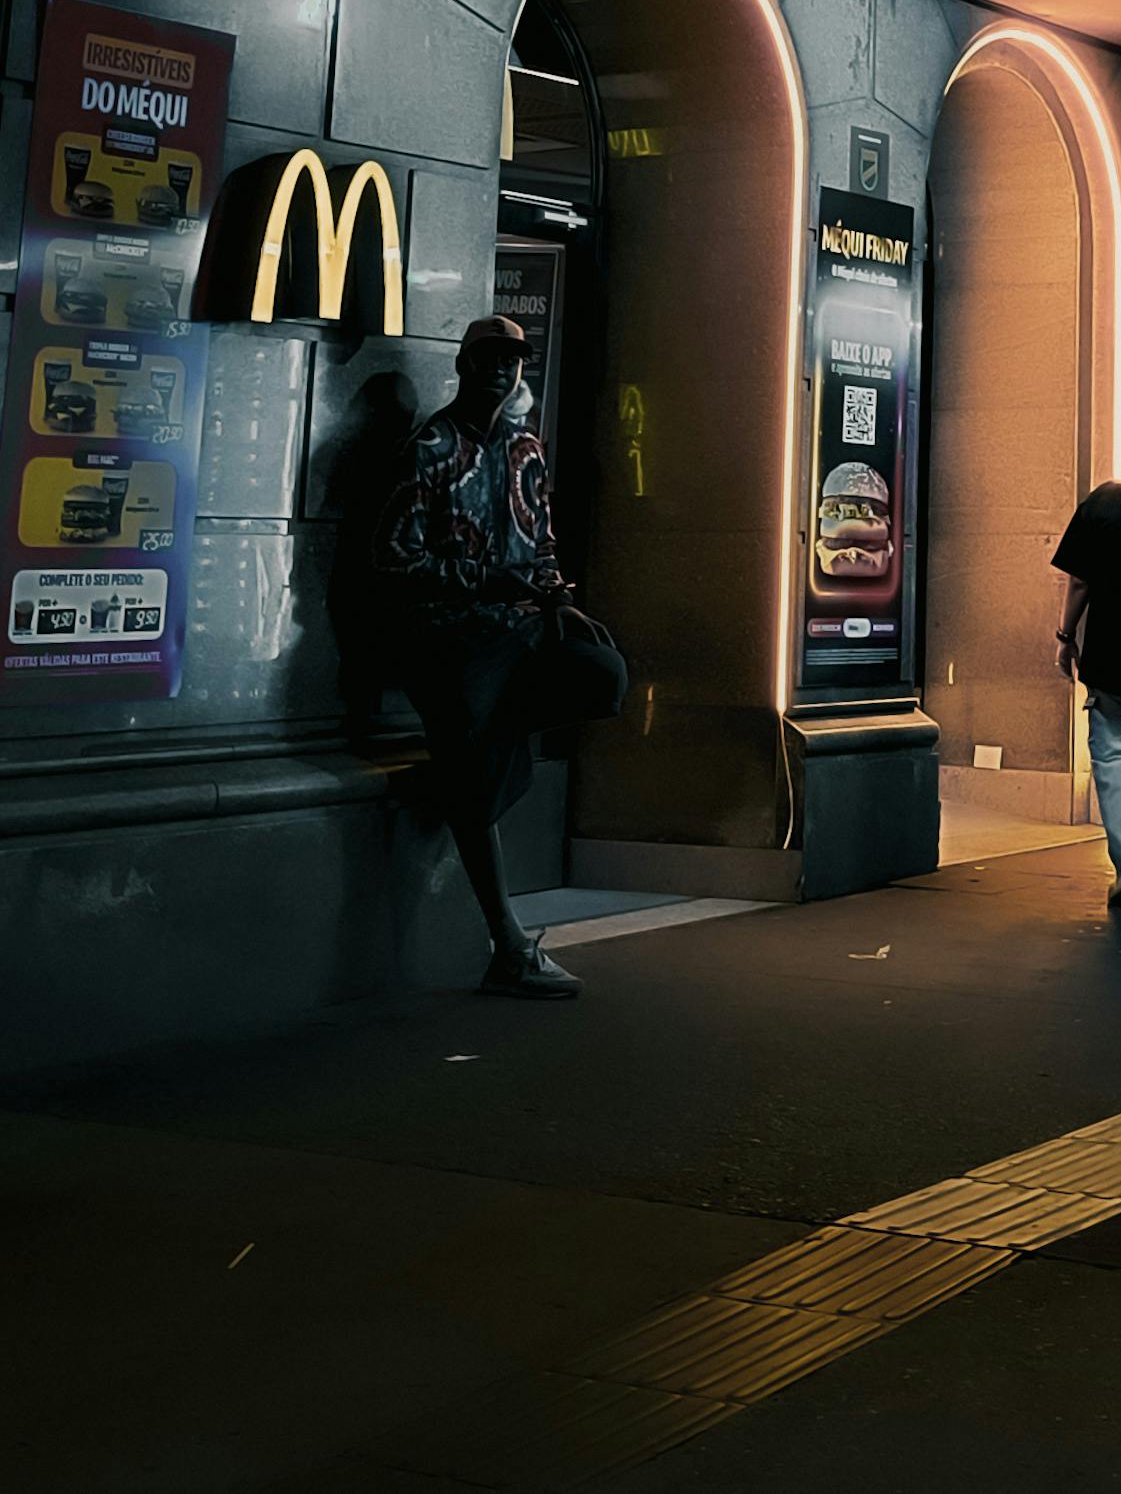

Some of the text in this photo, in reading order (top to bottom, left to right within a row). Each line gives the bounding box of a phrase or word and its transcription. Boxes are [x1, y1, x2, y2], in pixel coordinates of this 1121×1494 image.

[87, 42, 192, 83] IRRESISTÍVEIS
[81, 77, 189, 130] DO MÉQUI
[821, 219, 909, 266] MÉQUI FRIDAY
[831, 338, 892, 367] BAIXE O APP
[39, 574, 83, 587] COMPLETE
[85, 574, 92, 586] O
[93, 574, 110, 586] SEU
